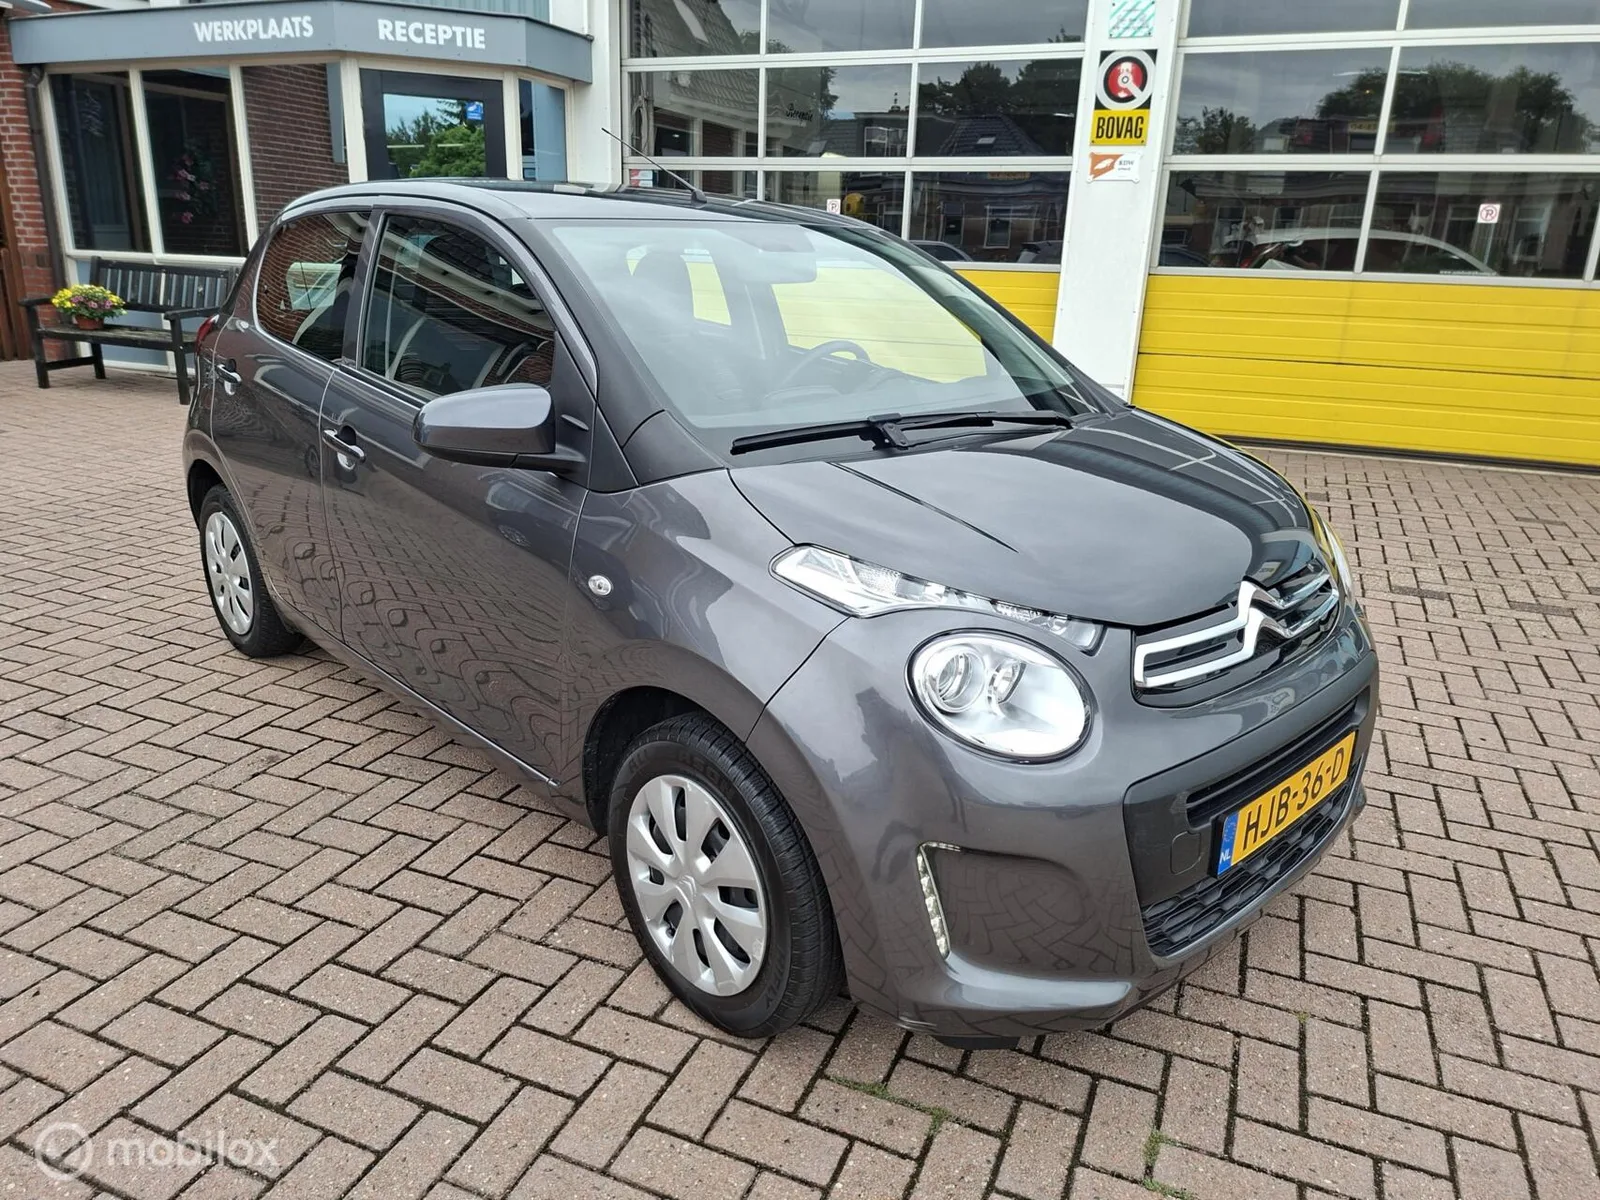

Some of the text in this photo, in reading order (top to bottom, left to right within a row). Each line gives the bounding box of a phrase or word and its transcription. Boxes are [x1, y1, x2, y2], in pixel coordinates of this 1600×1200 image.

[193, 15, 314, 43] WERKPLAATS
[377, 18, 486, 49] RECEPTIE
[1096, 115, 1144, 140] BOVAG
[1242, 746, 1345, 851] HJB-36-D
[1219, 848, 1231, 863] NL
